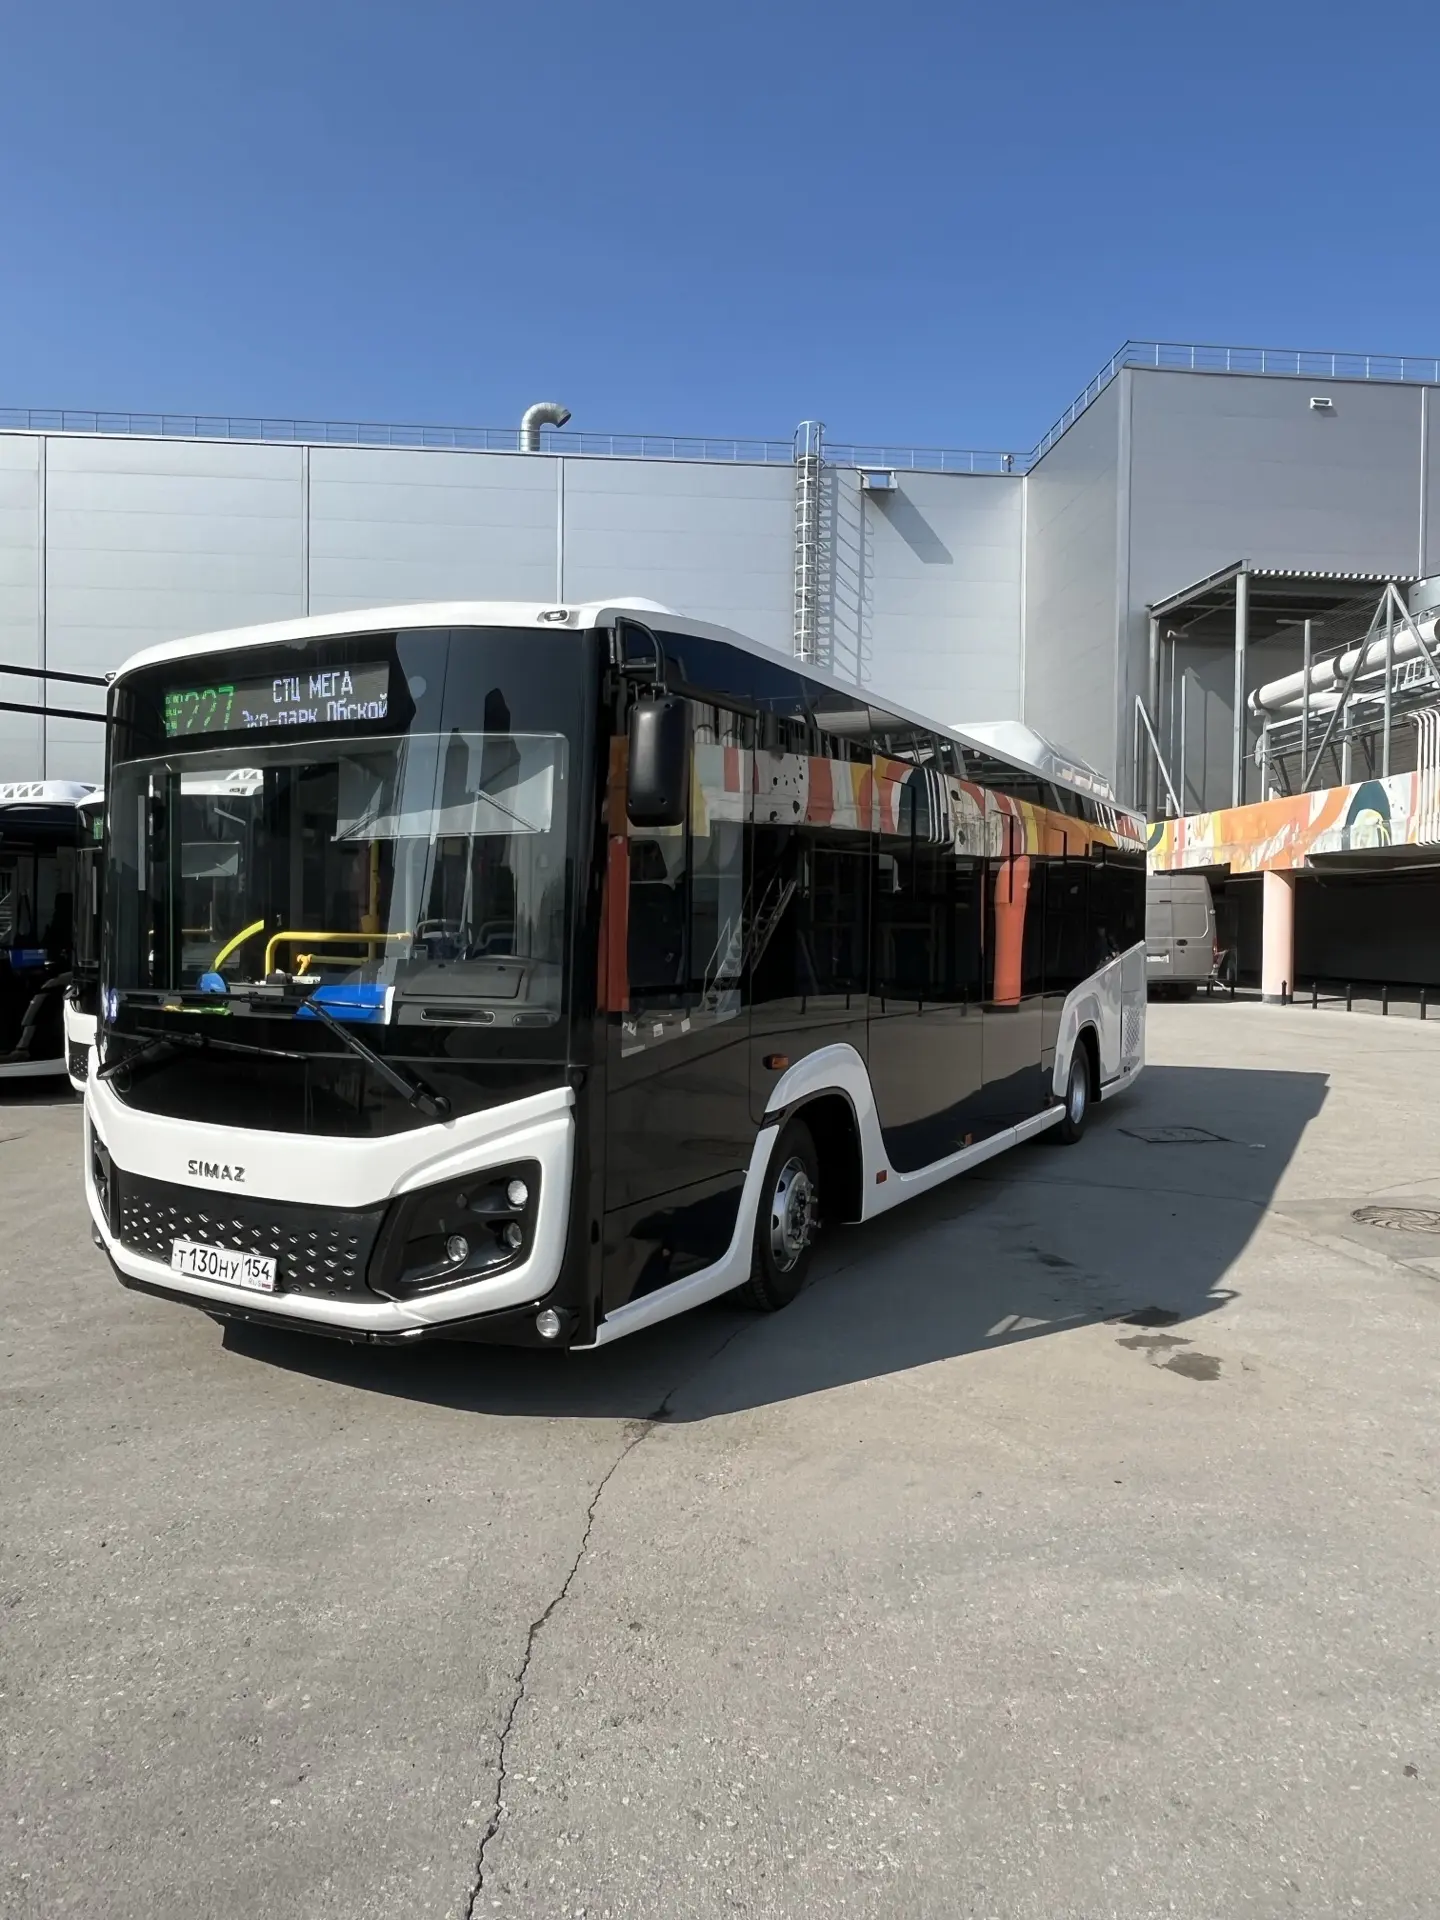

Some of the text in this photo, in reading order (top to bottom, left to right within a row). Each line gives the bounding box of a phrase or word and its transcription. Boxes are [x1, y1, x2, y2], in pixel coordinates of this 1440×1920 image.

[272, 670, 353, 703] СТЦ МЕГА
[187, 1159, 246, 1183] SIMAZ
[245, 1258, 272, 1281] 154
